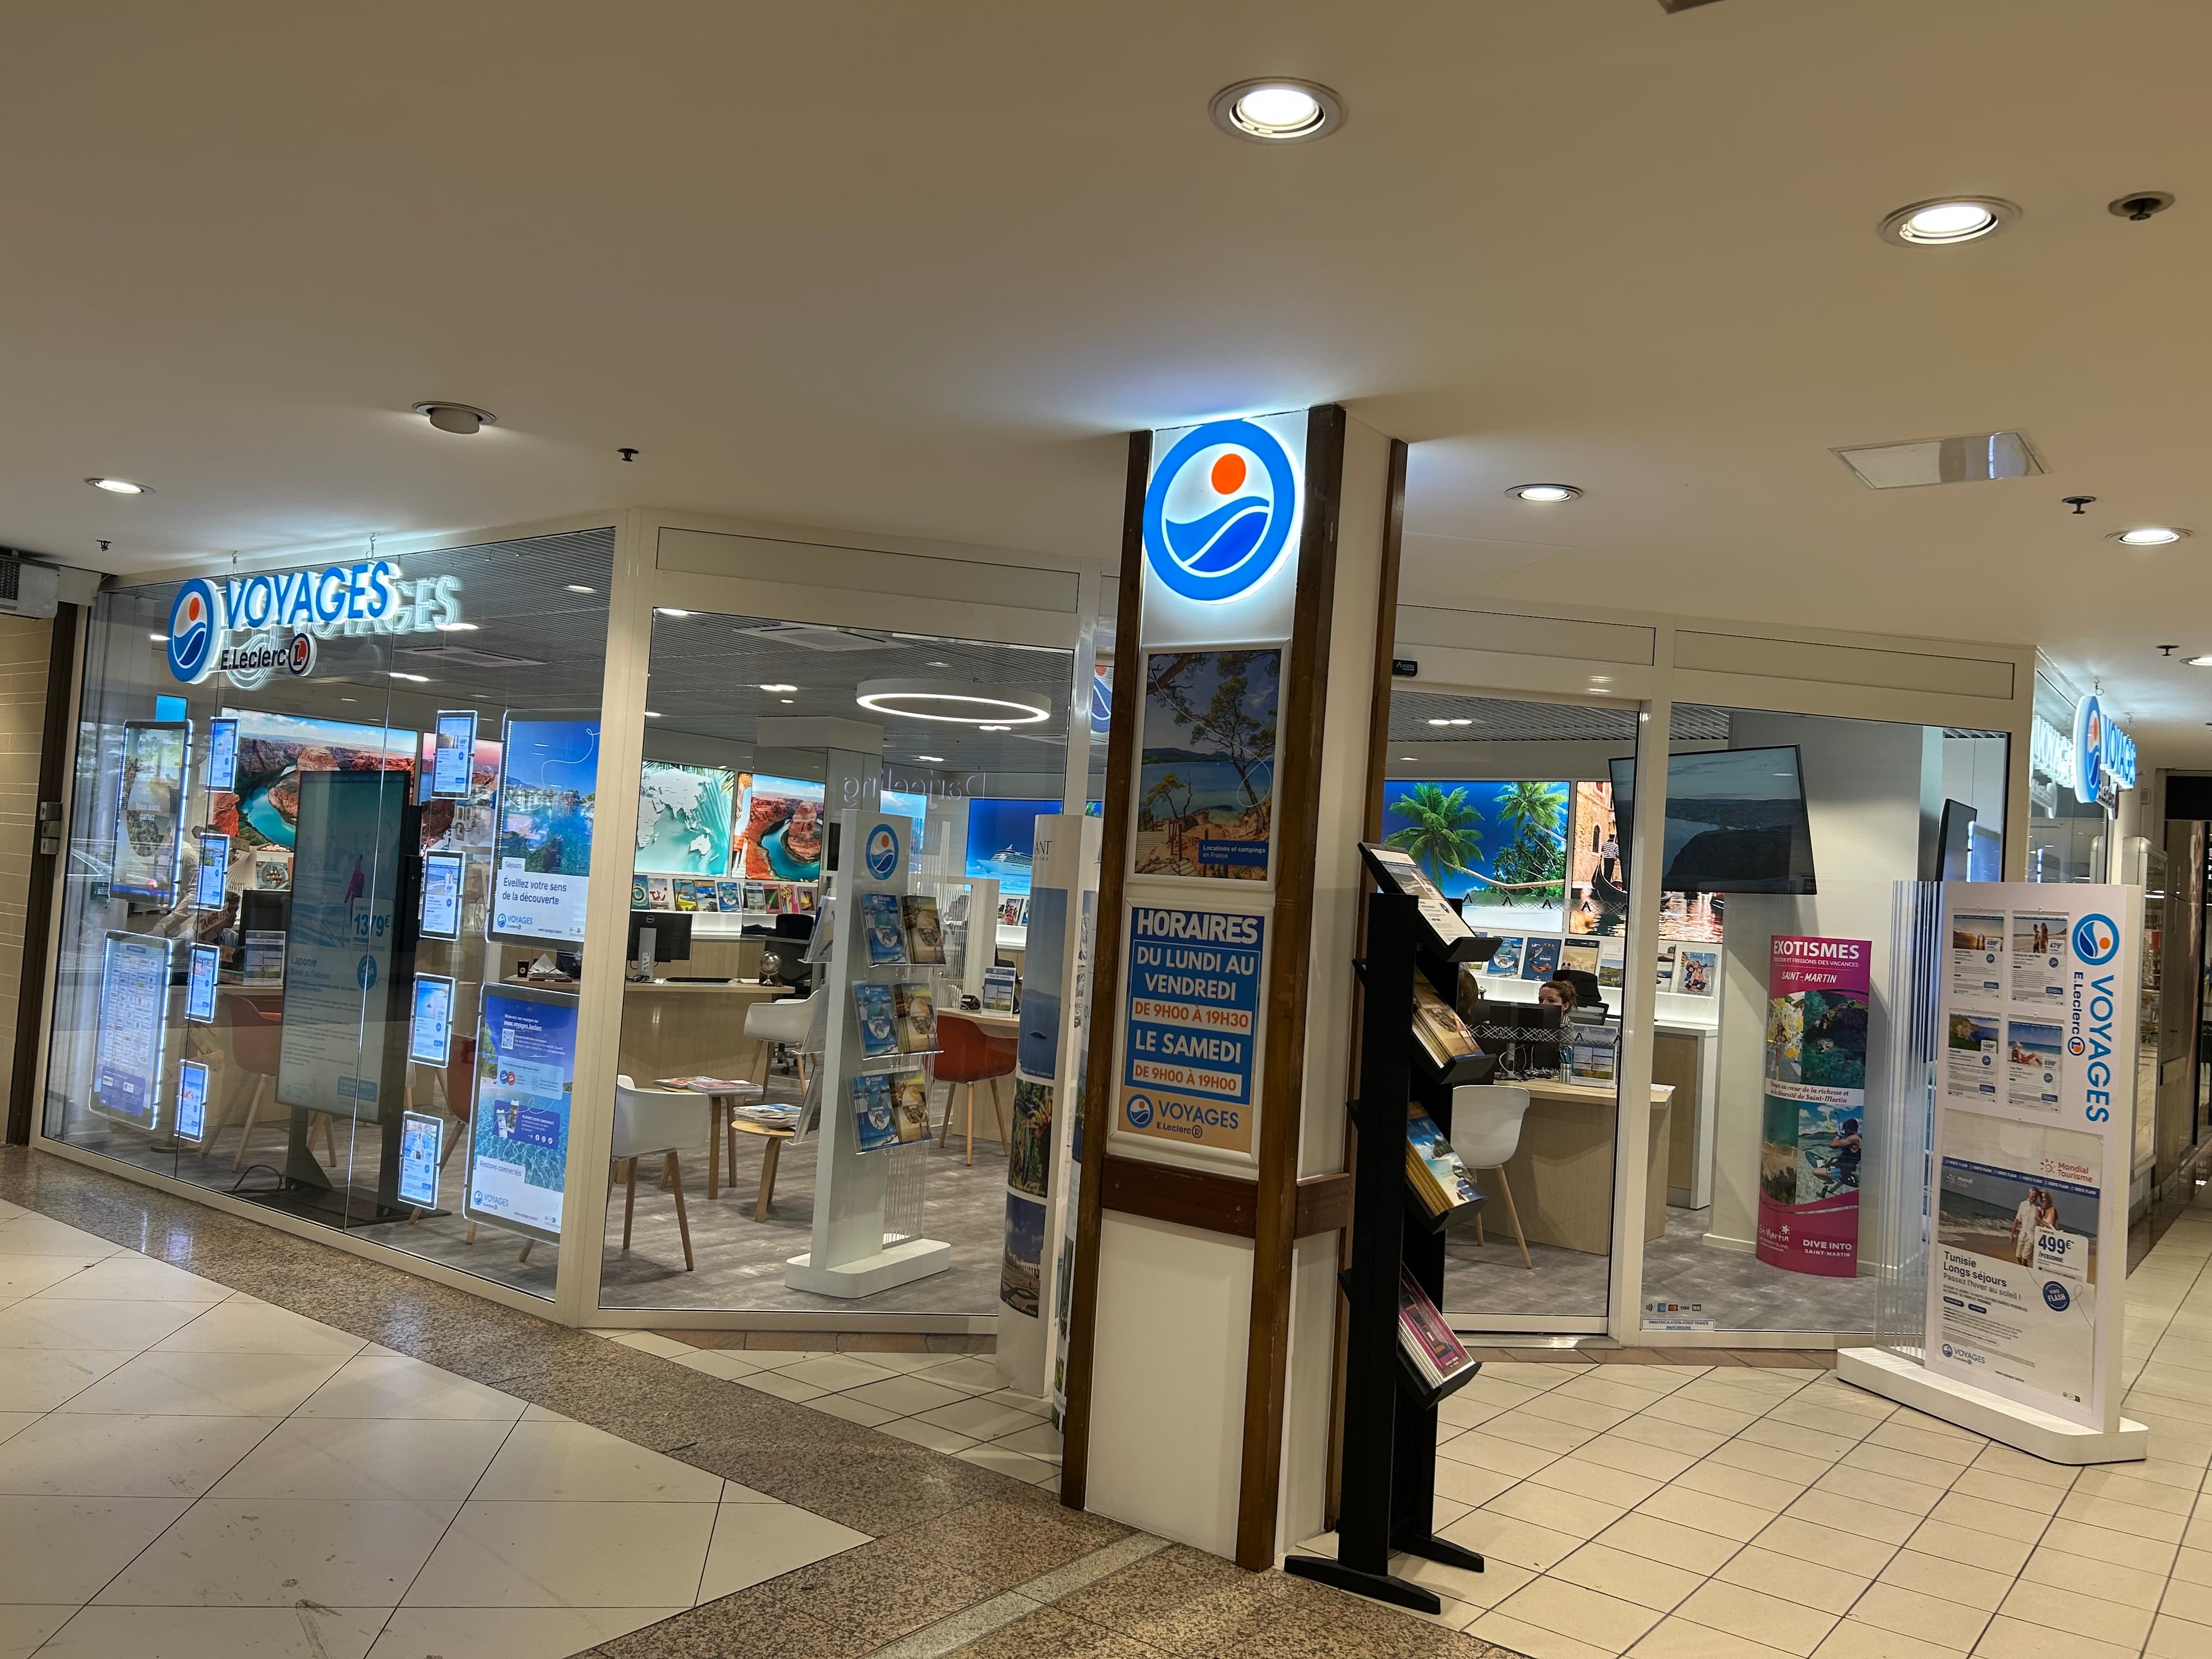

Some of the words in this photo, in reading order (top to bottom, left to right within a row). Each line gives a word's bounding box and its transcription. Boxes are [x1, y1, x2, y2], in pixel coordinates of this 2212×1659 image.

[226, 561, 397, 629] VOYAGES
[221, 647, 287, 671] E.Leclerc
[2100, 714, 2136, 788] VOYAG
[505, 861, 522, 869] Séjours
[503, 875, 528, 889] Éveillez
[531, 881, 548, 891] votre
[550, 884, 567, 892] sens
[502, 891, 510, 900] de
[512, 892, 518, 901] la
[520, 892, 559, 905] découverte
[507, 915, 533, 925] VOYAGES
[1137, 909, 1258, 944] HORAIRES
[1774, 940, 1859, 960] EXOTISMES
[291, 955, 317, 967] Laponie
[1137, 946, 1161, 966] DU
[1166, 949, 1221, 972] LUNDI
[1225, 955, 1254, 975] AU
[1145, 972, 1236, 1001] VENDREDI
[2072, 972, 2084, 1035] E.Leclerc
[1135, 1001, 1150, 1016] DE
[1154, 1004, 1189, 1020] 9H00
[1192, 1003, 1202, 1022] À
[1206, 1010, 1249, 1028] 19H30
[1135, 1029, 1157, 1051] LE
[1161, 1033, 1241, 1063] SAMEDI
[2086, 975, 2114, 1122] VOYAGES
[1135, 1065, 1149, 1078] DE
[1152, 1067, 1183, 1083] 9H00
[1186, 1069, 1195, 1085] À
[1198, 1074, 1236, 1090] 19H00
[1805, 1094, 1847, 1103] Saint-Martin
[1158, 1100, 1238, 1129] VOYAGES
[1157, 1122, 1191, 1134] E.Leclerc
[480, 1160, 497, 1171] Restons
[498, 1166, 521, 1177] connectés
[2057, 1169, 2092, 1183] Tourisme
[2058, 1162, 2089, 1174] Mondial
[484, 1194, 509, 1207] VOYAGES
[1803, 1239, 1827, 1248] DIVE
[1829, 1242, 1852, 1250] INTO
[1805, 1248, 1850, 1257] SAINT-MARTIN
[1944, 1251, 1976, 1267] Tunisie
[1944, 1262, 1970, 1277] Longs
[1972, 1271, 2007, 1287] séjours
[1943, 1272, 1966, 1285] Passez
[1999, 1289, 2017, 1300] soleil
[2048, 1293, 2066, 1302] FLASH
[1953, 1347, 1985, 1364] VOYAGES
